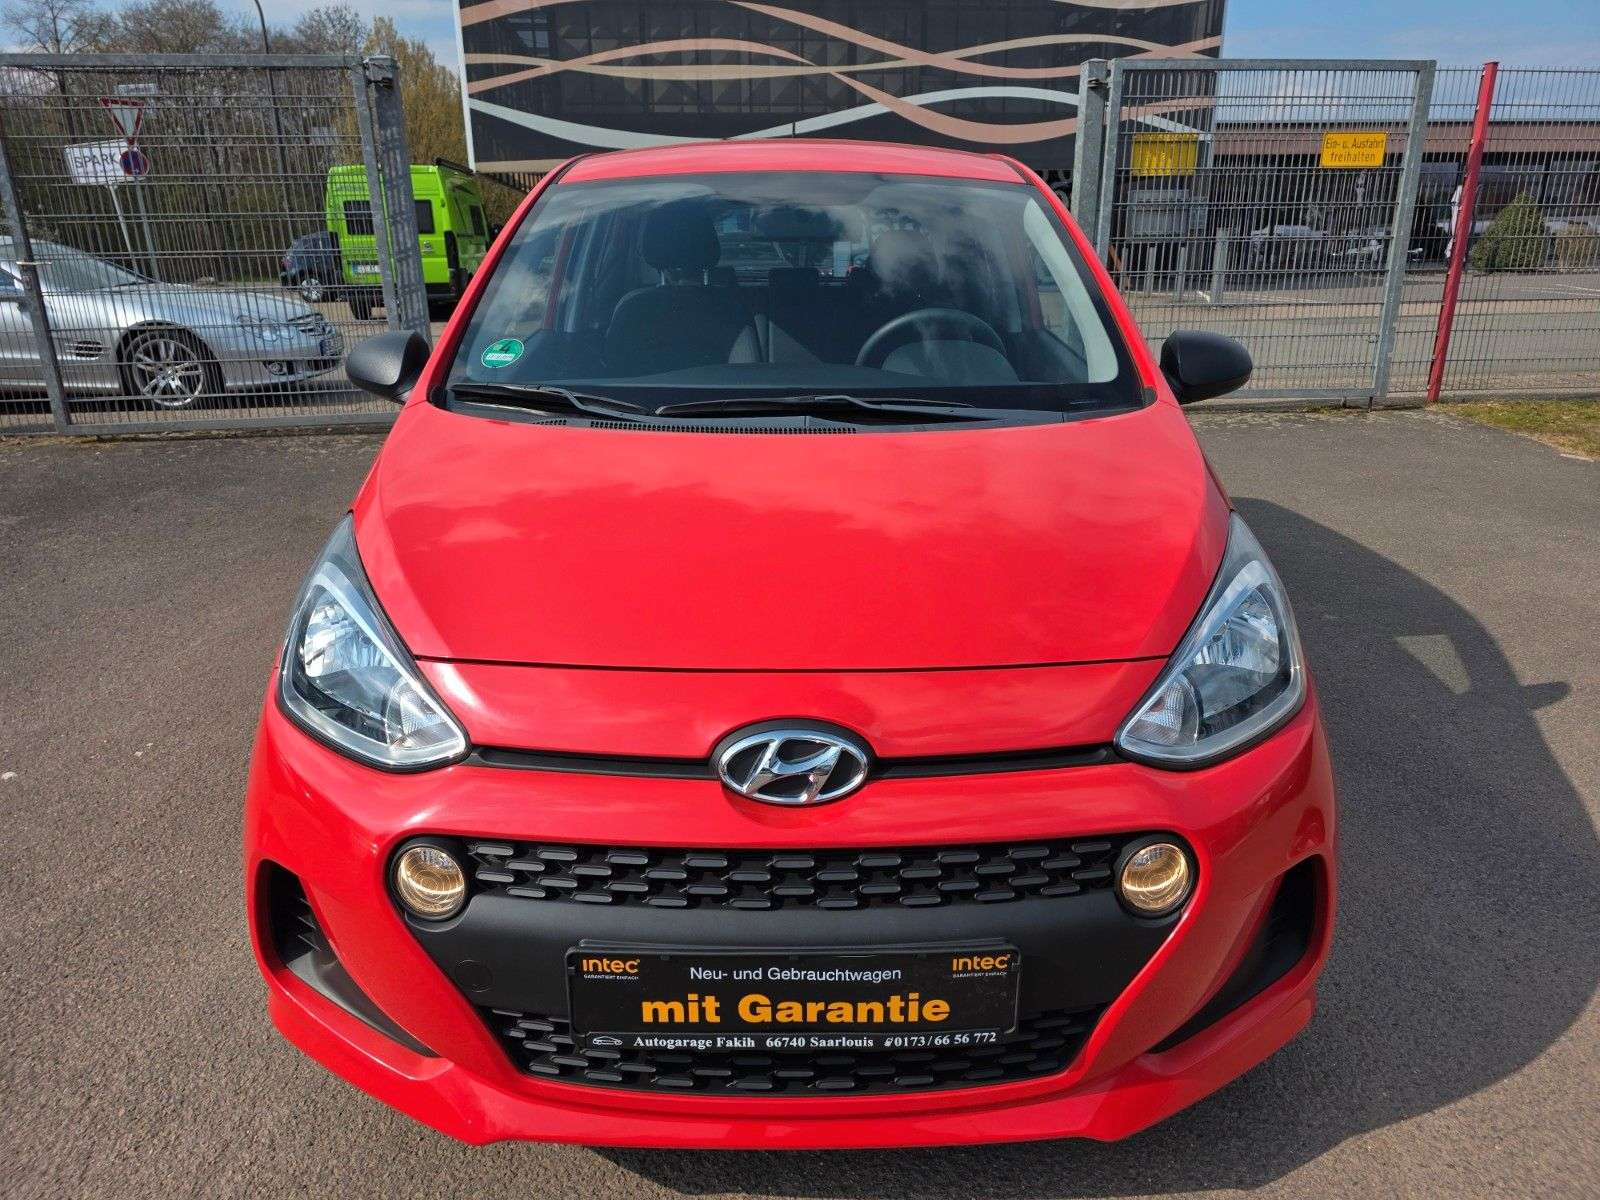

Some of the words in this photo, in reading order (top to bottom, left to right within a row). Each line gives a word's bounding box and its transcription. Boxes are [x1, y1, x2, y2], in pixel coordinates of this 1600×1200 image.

[1330, 151, 1376, 162] freihalten
[499, 340, 512, 353] 4
[689, 966, 728, 980] Neu-
[733, 967, 763, 980] und
[767, 966, 902, 983] Gebrauchtwagen
[642, 993, 721, 1023] mit
[738, 992, 950, 1024] Garantie
[633, 1036, 713, 1050] Autogarage
[716, 1036, 756, 1048] Fakih
[765, 1037, 806, 1048] 66740
[809, 1037, 874, 1048] Saarlouis
[953, 1033, 971, 1045] 56
[974, 1032, 998, 1044] 772
